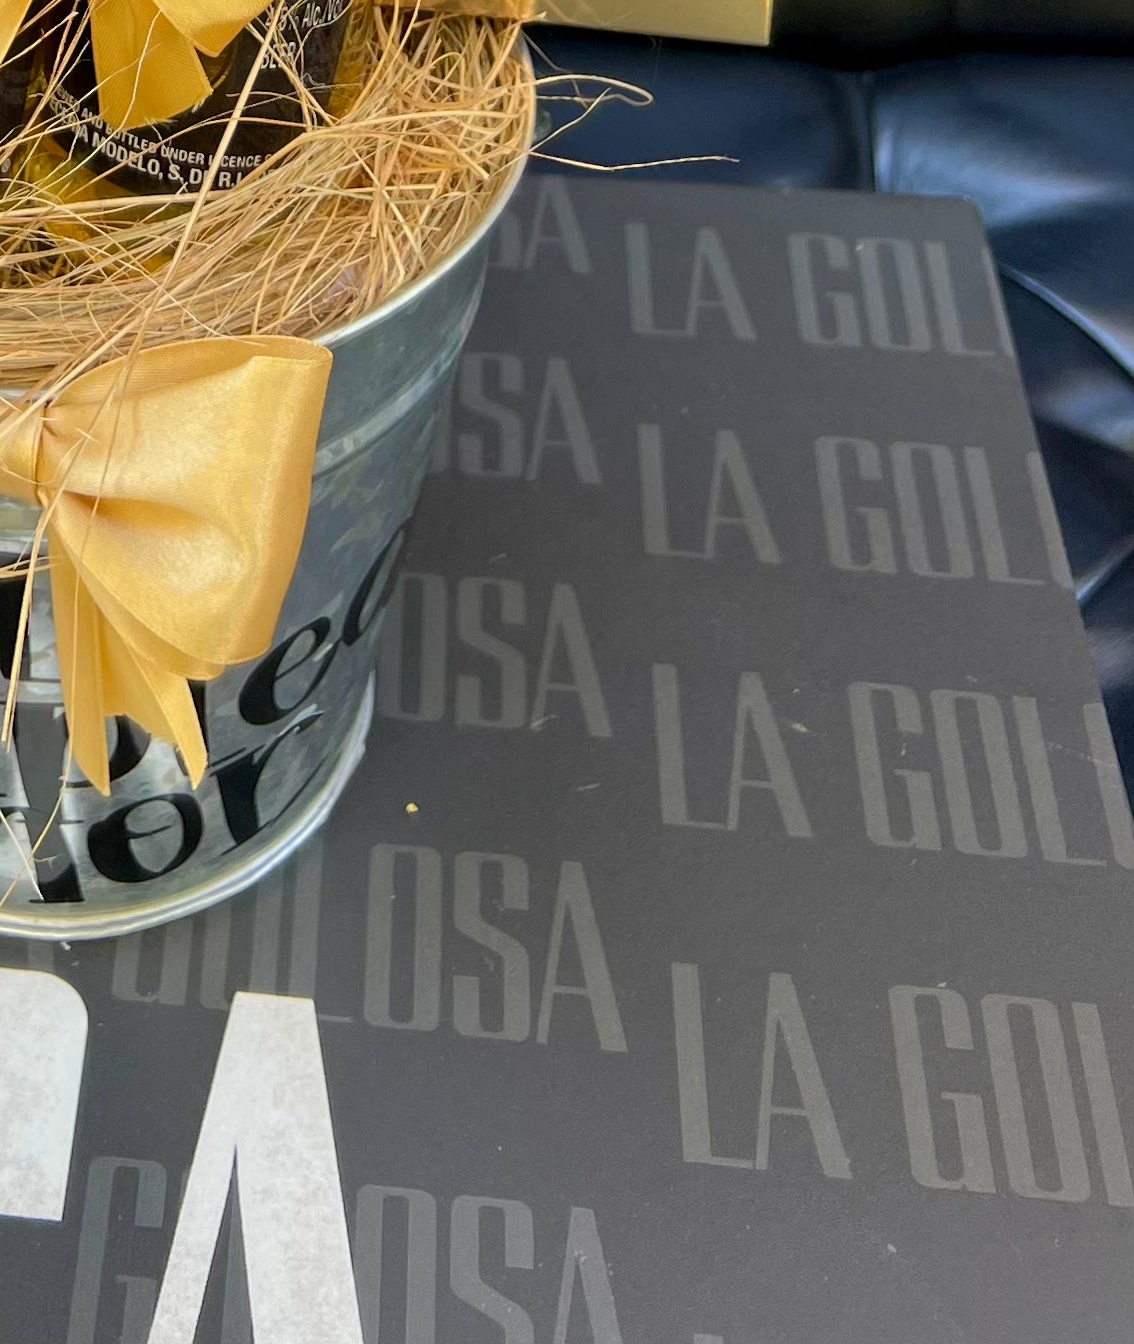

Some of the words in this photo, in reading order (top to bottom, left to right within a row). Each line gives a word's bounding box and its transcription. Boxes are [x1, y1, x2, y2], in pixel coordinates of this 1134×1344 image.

[160, 144, 205, 165] UNDER
[623, 220, 758, 342] LA
[636, 420, 783, 566] LA
[650, 663, 814, 839] LA
[670, 961, 854, 1181] LA
